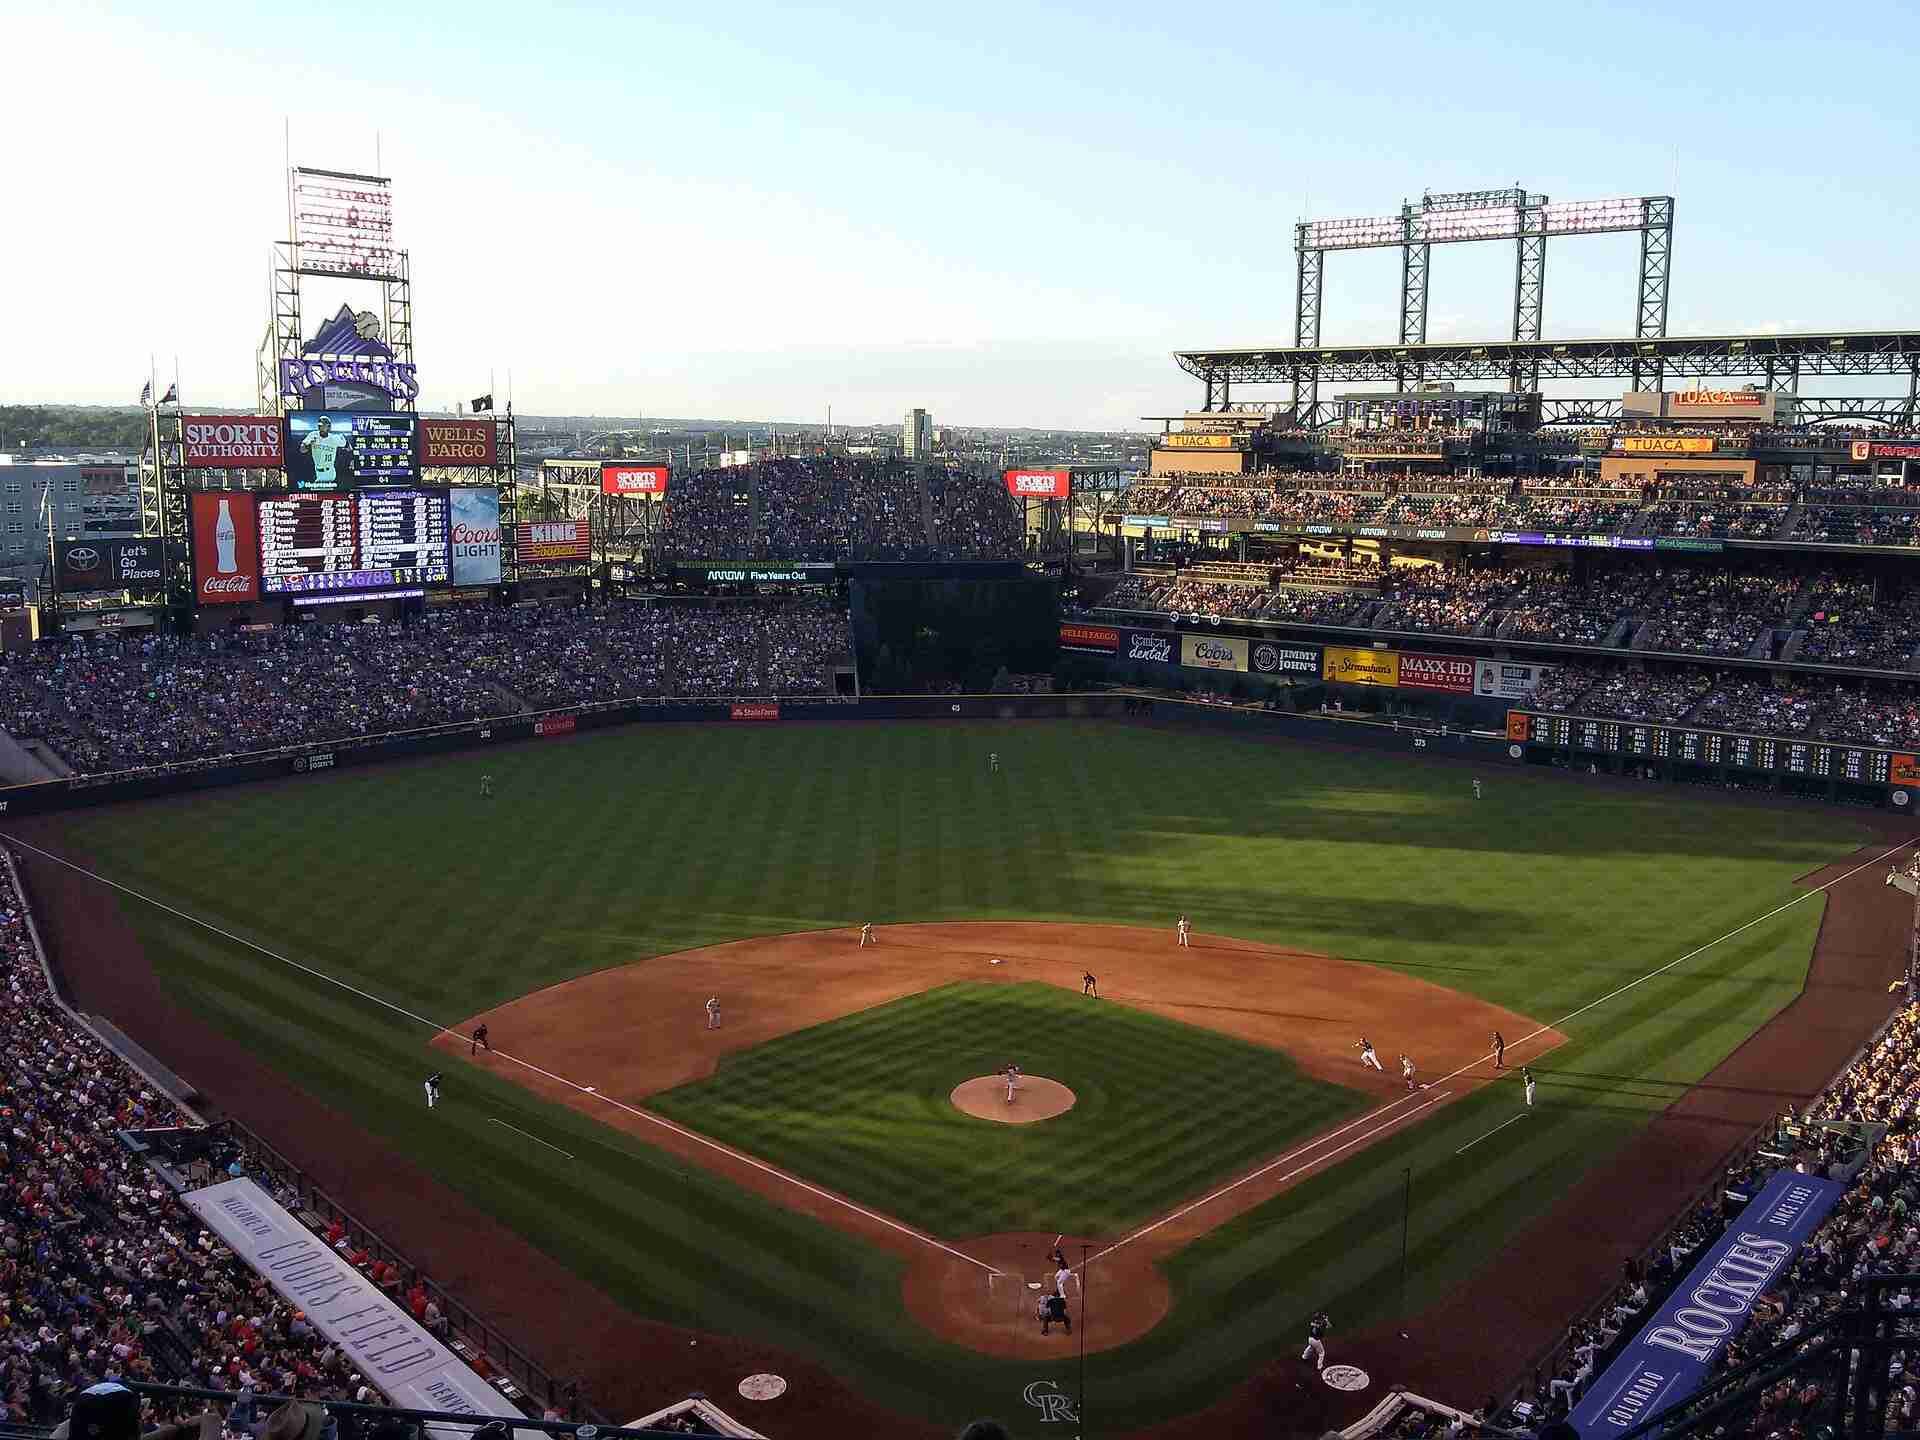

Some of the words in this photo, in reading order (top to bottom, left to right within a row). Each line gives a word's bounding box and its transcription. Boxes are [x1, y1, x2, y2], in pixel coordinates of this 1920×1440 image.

[279, 359, 420, 399] ROCKIES
[1678, 391, 1733, 403] TUACA
[187, 424, 279, 444] SPORTS
[426, 427, 486, 442] WELLS
[1174, 436, 1211, 446] TUACA
[428, 443, 486, 458] FARGO
[1633, 439, 1684, 450] TUACA
[617, 472, 657, 481] SPORTS
[1016, 475, 1056, 486] SPORTS
[452, 523, 499, 543] Coors
[531, 523, 577, 541] KING
[121, 546, 148, 556] Let's
[456, 545, 497, 557] LIGHT
[121, 558, 138, 568] Go
[122, 569, 160, 579] Places
[708, 571, 745, 580] ARROW
[750, 571, 767, 580] Five
[767, 571, 788, 580] Years
[790, 571, 806, 580] Out
[203, 575, 252, 594] Coca-Cola
[1089, 631, 1117, 642] FARGO
[1128, 645, 1171, 662] dental
[1194, 643, 1233, 662] Coors
[1280, 649, 1318, 661] JIMMY
[1279, 660, 1318, 672] JOHN'S
[1342, 656, 1392, 674] Stranahan's
[1401, 656, 1447, 674] MAXX
[1449, 662, 1472, 676] HD
[1400, 670, 1472, 684] sunglasses
[222, 1197, 262, 1228] WELCOME
[251, 1224, 273, 1236] TO
[1768, 1203, 1800, 1227] SINCE
[1643, 1231, 1793, 1361] ROCKIES
[257, 1239, 362, 1306] COORS
[327, 1304, 436, 1374] FIELD
[1607, 1370, 1665, 1427] COLORADO
